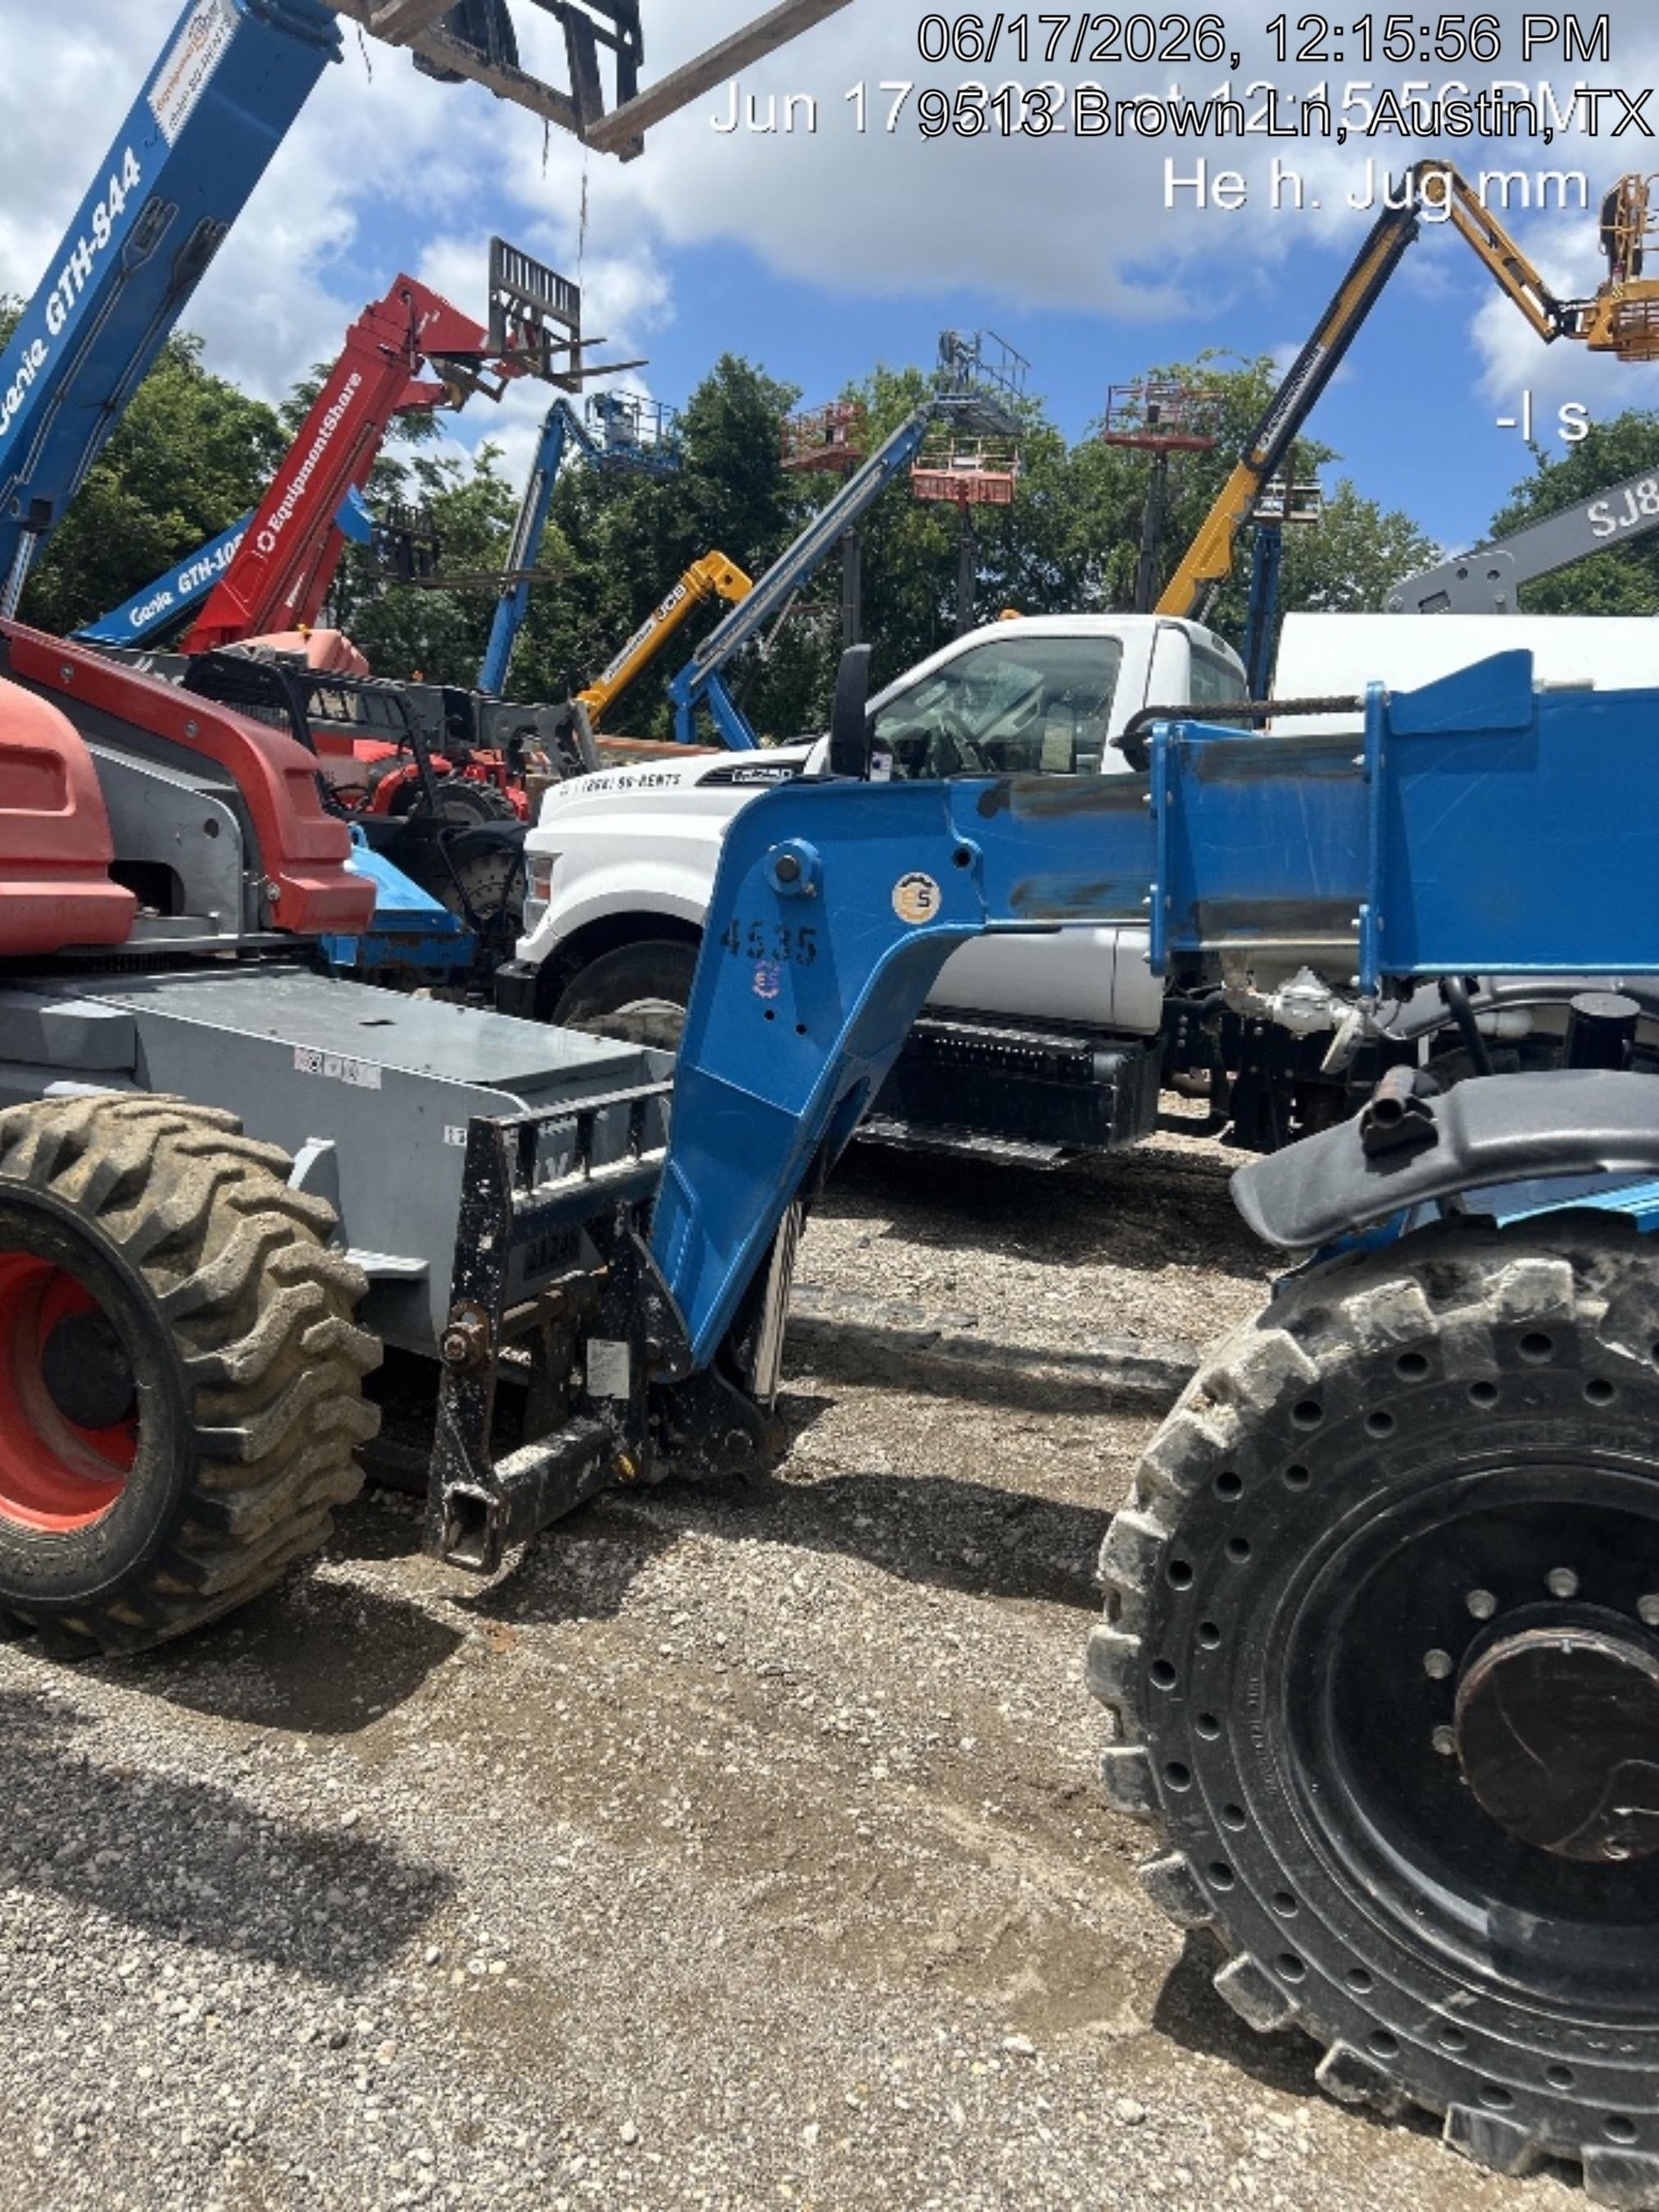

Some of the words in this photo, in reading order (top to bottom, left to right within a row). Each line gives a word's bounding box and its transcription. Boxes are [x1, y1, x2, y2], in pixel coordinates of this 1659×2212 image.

[45, 146, 142, 336] GTH-844
[267, 373, 362, 533] EquipmentShare
[129, 590, 175, 628] Genie
[658, 583, 687, 620] JCB
